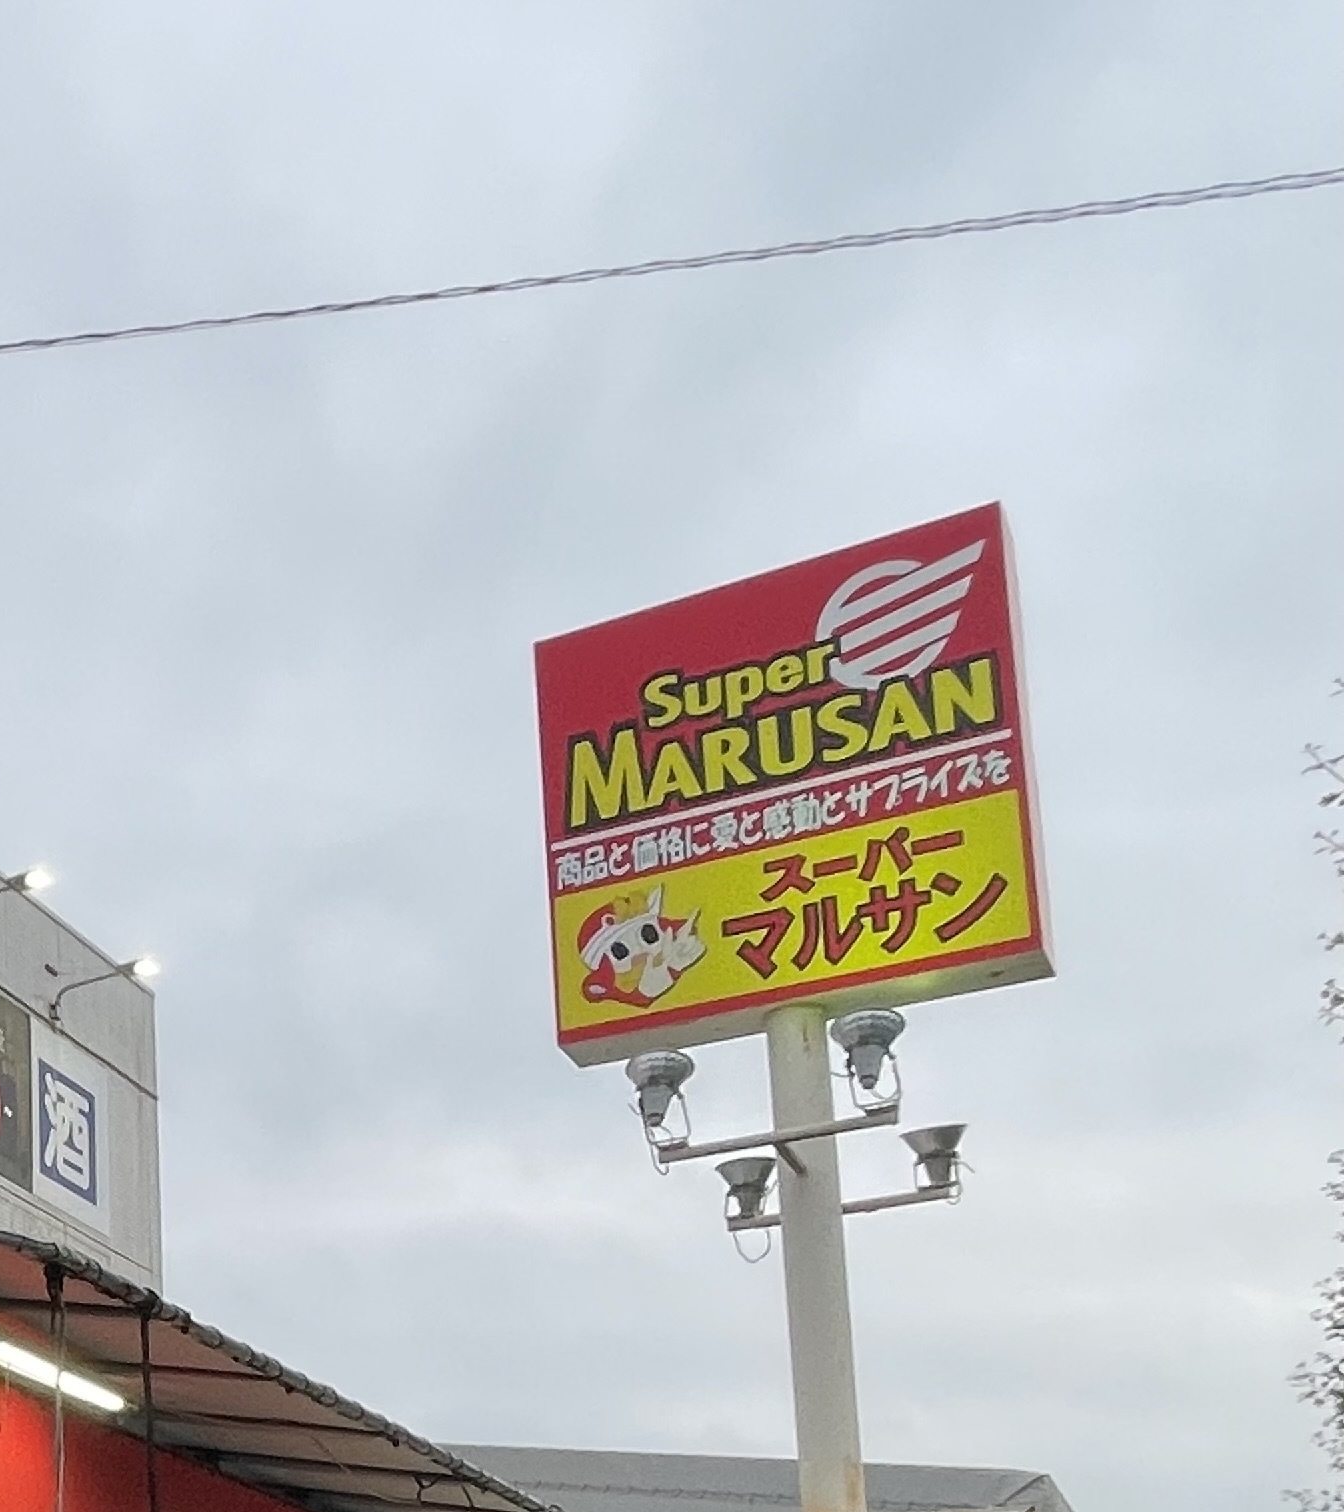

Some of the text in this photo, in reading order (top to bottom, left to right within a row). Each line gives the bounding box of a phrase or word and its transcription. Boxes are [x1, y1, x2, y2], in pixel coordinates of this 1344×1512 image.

[644, 642, 838, 728] Super
[569, 659, 997, 828] MARUSAN
[759, 826, 964, 900] スーパー
[721, 873, 1008, 979] マルサン
[43, 1071, 91, 1192] 酒
